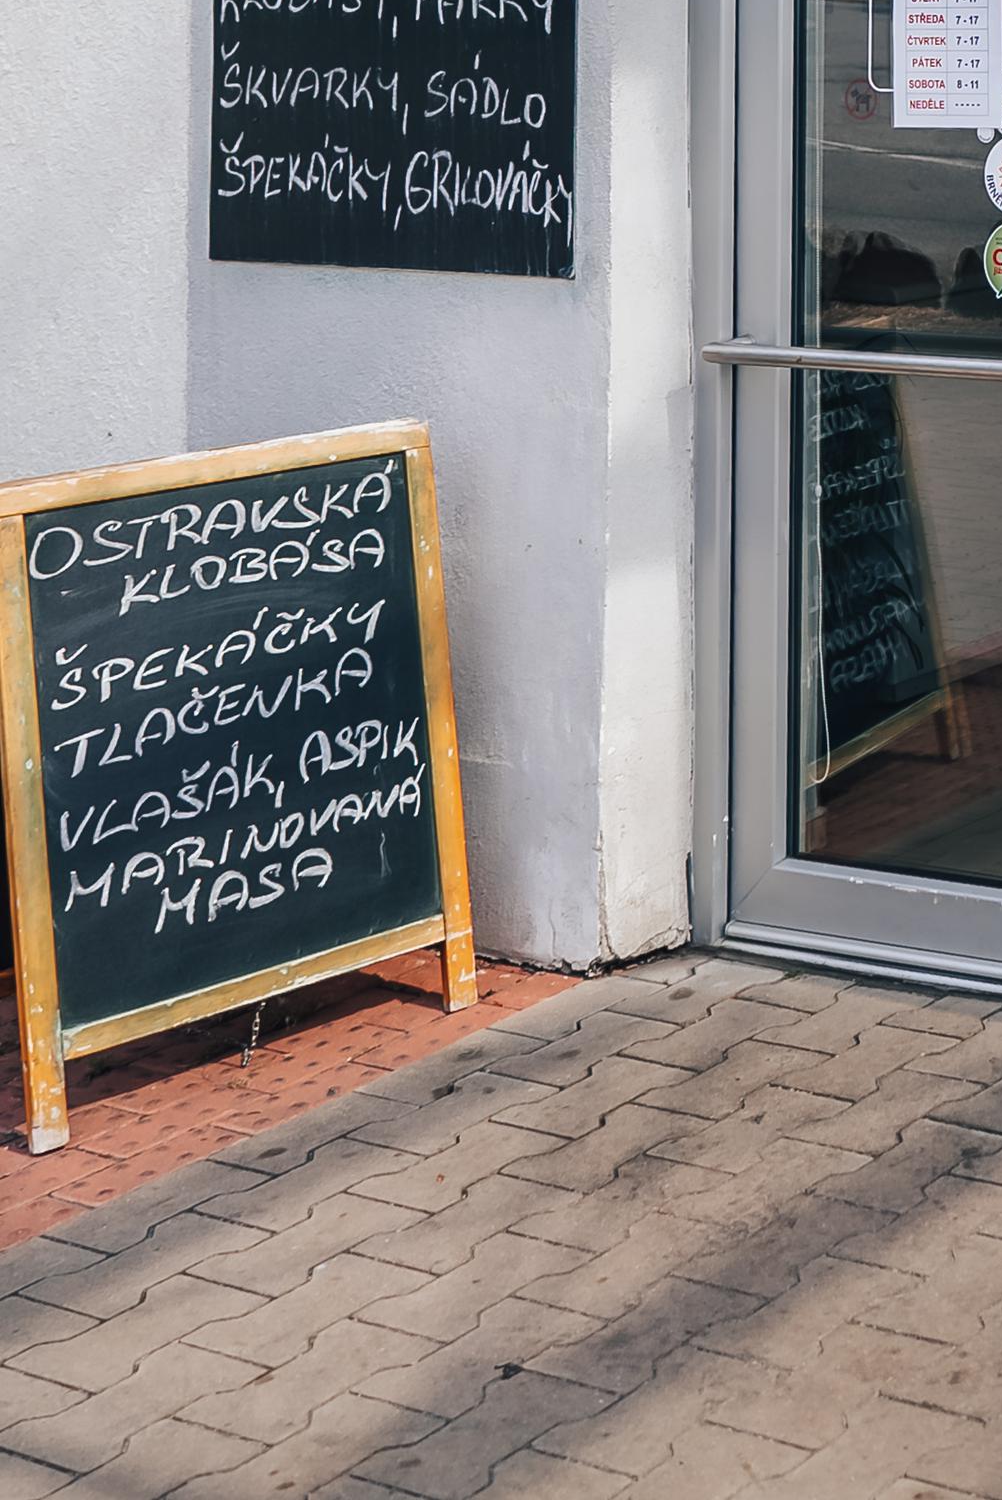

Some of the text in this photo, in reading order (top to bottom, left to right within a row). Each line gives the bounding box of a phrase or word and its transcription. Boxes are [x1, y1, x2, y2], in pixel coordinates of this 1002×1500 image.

[907, 35, 946, 45] ČTVRTEK
[970, 36, 980, 45] 17
[908, 13, 945, 23] STŘEDA
[969, 16, 979, 24] 17
[912, 56, 942, 67] PÁTEK
[970, 59, 980, 68] 17
[219, 41, 546, 135] ŠKVARKY, SÁDLO
[908, 79, 945, 89] SOBOTA
[970, 80, 979, 89] 11
[909, 98, 945, 109] NEDĚLE
[218, 131, 573, 247] ŠPEKÁČKY, GRILOVÁČKY
[29, 459, 396, 580] OSTRAVSKÁ
[118, 529, 386, 617] KLOBÁSA
[51, 599, 386, 711] ŠPEKÁČKY
[54, 647, 374, 779] TLAČENKA
[60, 716, 421, 852] VLAŠÁK, ASPIK
[65, 763, 427, 913] MARINOVANÁ
[154, 848, 334, 934] MASA
